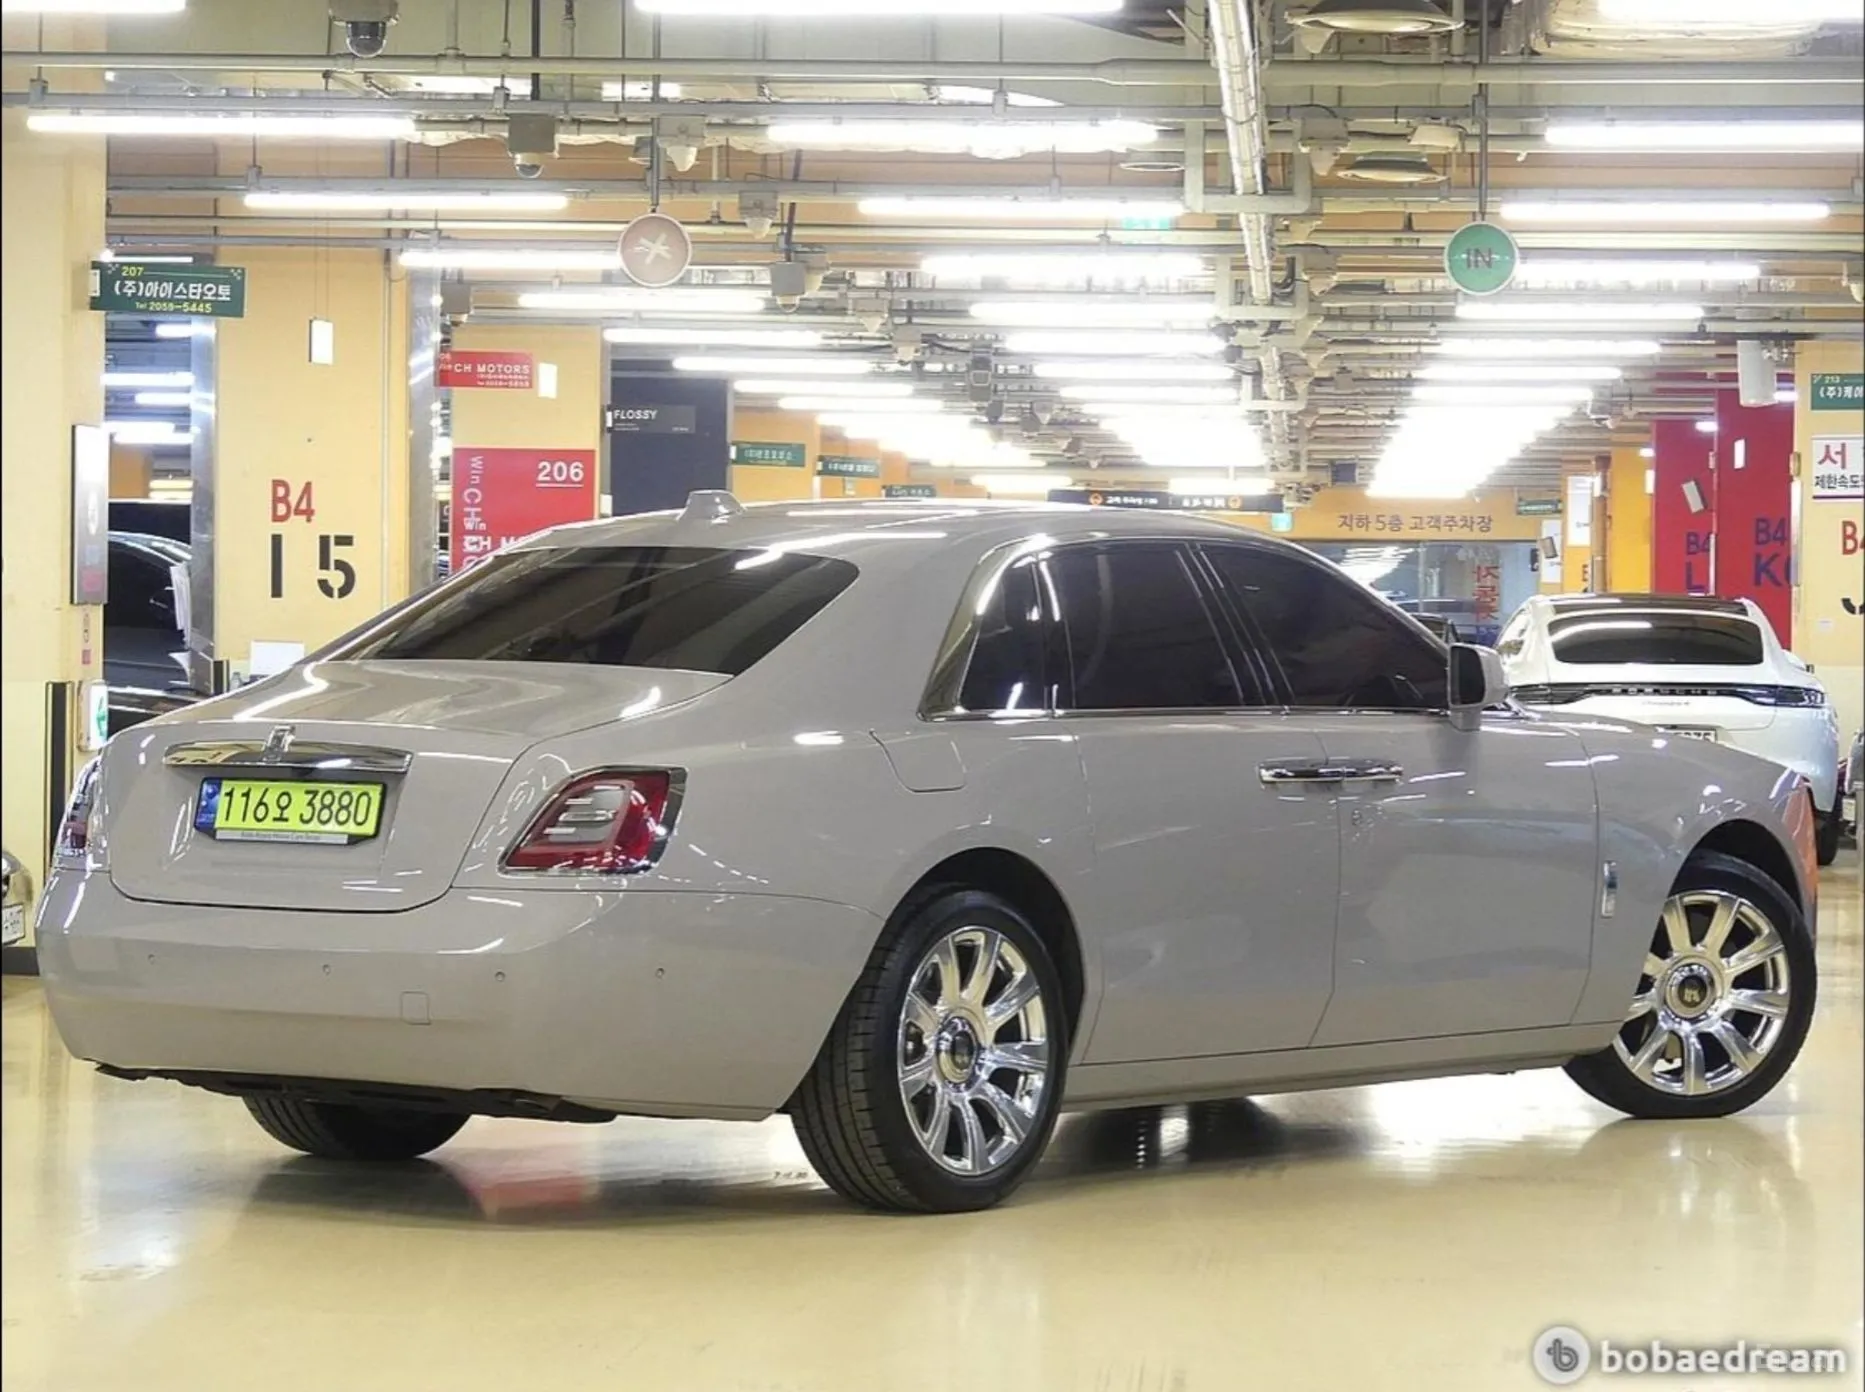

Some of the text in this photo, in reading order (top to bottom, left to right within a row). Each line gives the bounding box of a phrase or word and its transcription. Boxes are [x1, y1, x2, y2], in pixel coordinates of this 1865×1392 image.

[1466, 248, 1493, 269] IN
[121, 266, 144, 277] 207
[114, 279, 232, 301] (주)아이스타오토
[477, 363, 530, 374] MOTORS
[614, 409, 658, 420] FLOSSY
[537, 461, 584, 482] 206
[1814, 474, 1864, 490] 제한속도
[271, 479, 315, 523] B4
[1338, 514, 1371, 532] 지하
[1409, 514, 1493, 533] 고객주차장
[1755, 518, 1787, 546] B4
[1841, 520, 1864, 556] B
[224, 786, 372, 827] 116오 3880
